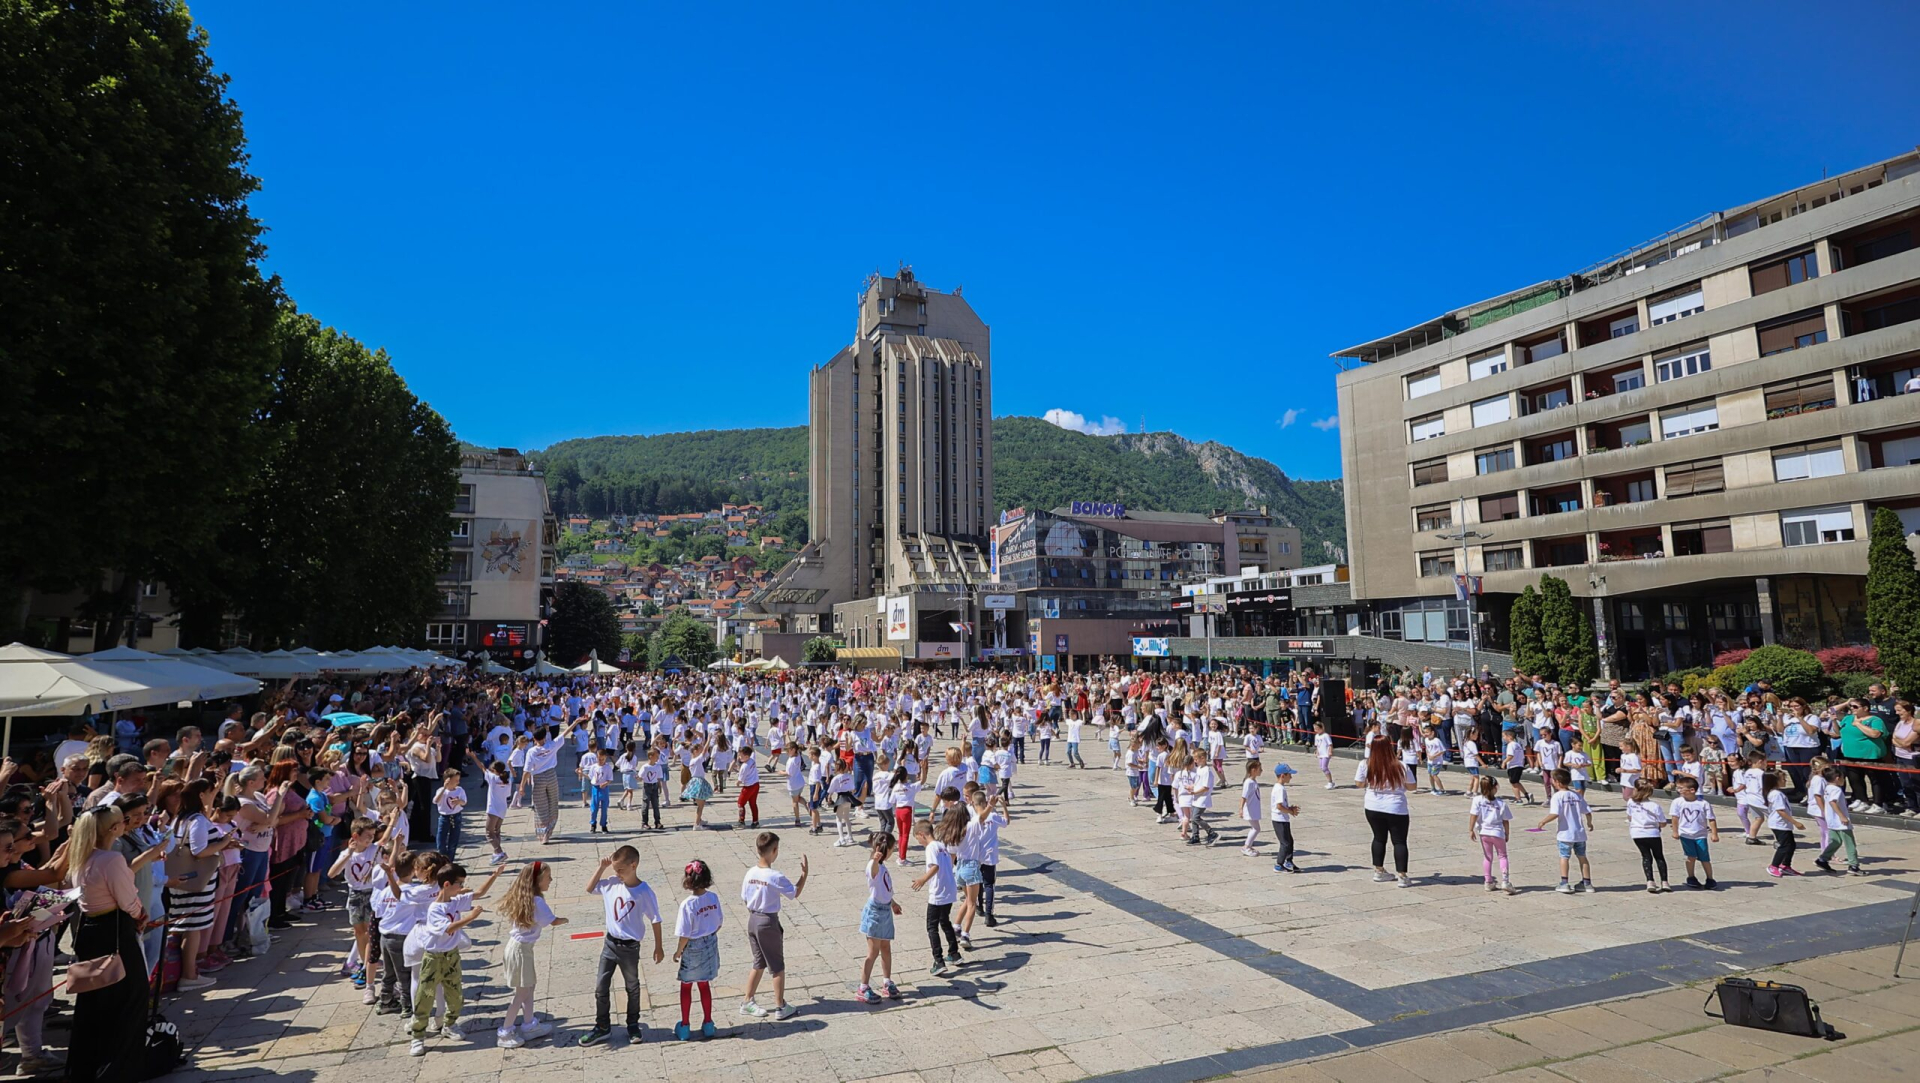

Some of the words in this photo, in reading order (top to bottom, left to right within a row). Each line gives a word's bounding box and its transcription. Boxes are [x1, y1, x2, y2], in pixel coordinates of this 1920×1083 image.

[1071, 500, 1126, 517] BOHOR
[893, 603, 905, 623] dm
[936, 645, 949, 653] dm
